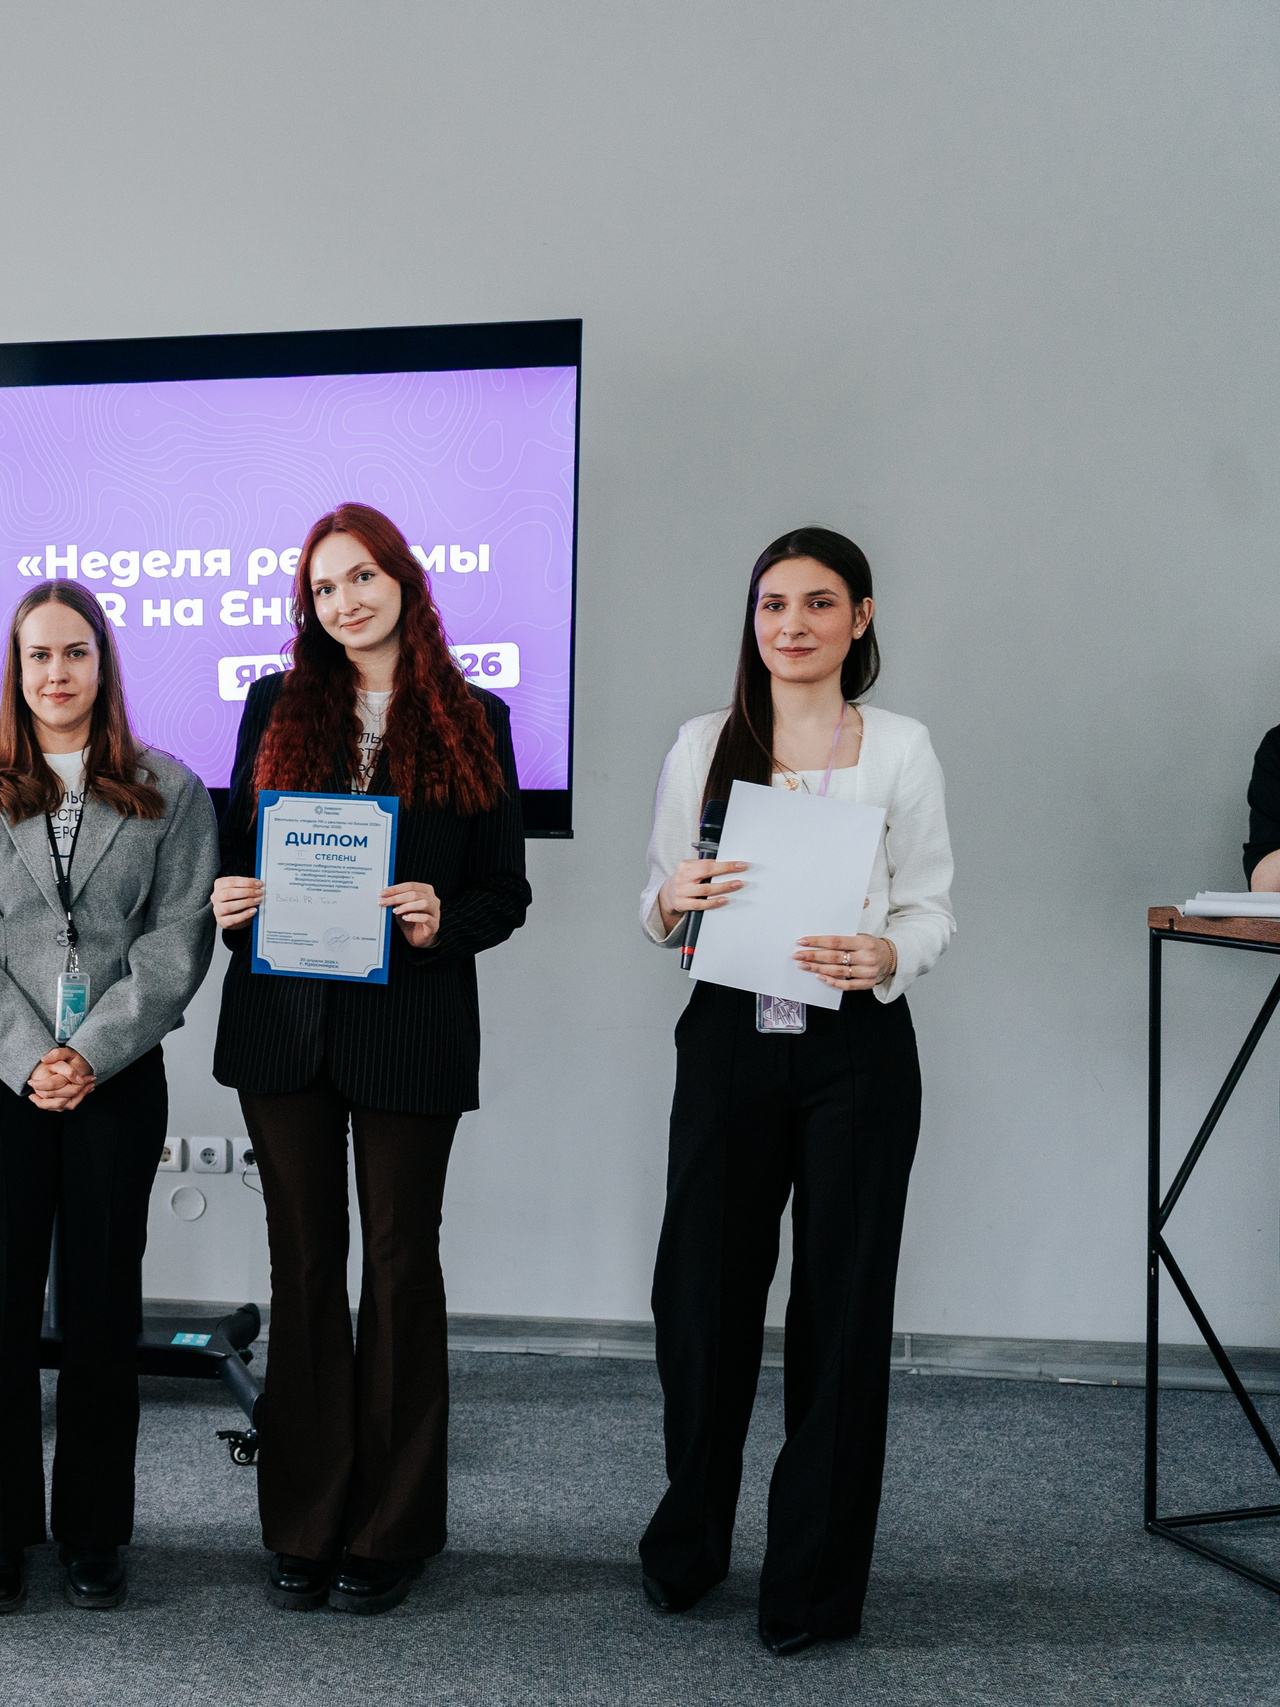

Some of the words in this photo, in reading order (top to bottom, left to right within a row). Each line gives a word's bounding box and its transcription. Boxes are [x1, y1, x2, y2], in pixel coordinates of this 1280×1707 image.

[17, 545, 231, 588] «Неделя
[142, 598, 204, 627] на
[285, 831, 368, 848] ДИПЛОМ
[314, 853, 357, 862] СТЕПЕНИ
